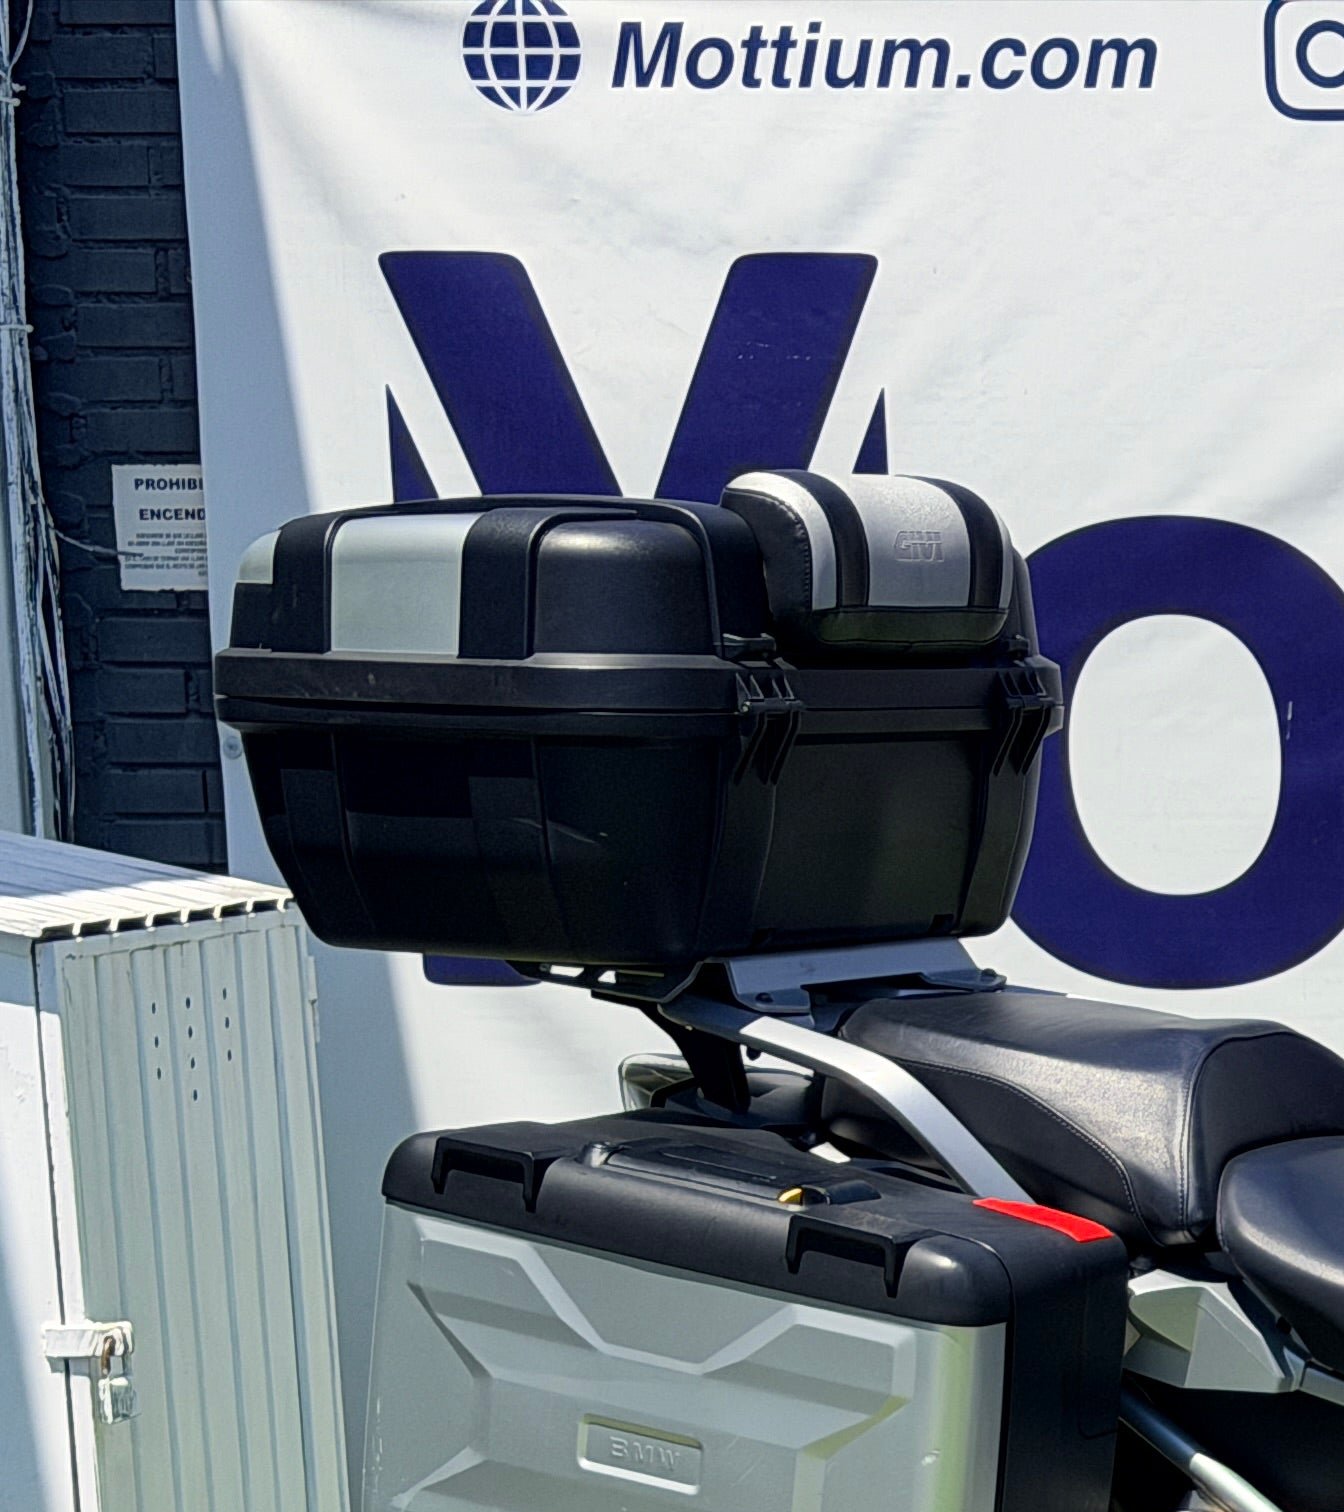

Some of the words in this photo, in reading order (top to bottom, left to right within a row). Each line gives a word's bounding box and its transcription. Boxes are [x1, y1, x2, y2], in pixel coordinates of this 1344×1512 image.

[611, 21, 1158, 90] Mottium.com
[893, 529, 945, 563] GIVI
[608, 1435, 682, 1472] BMW
